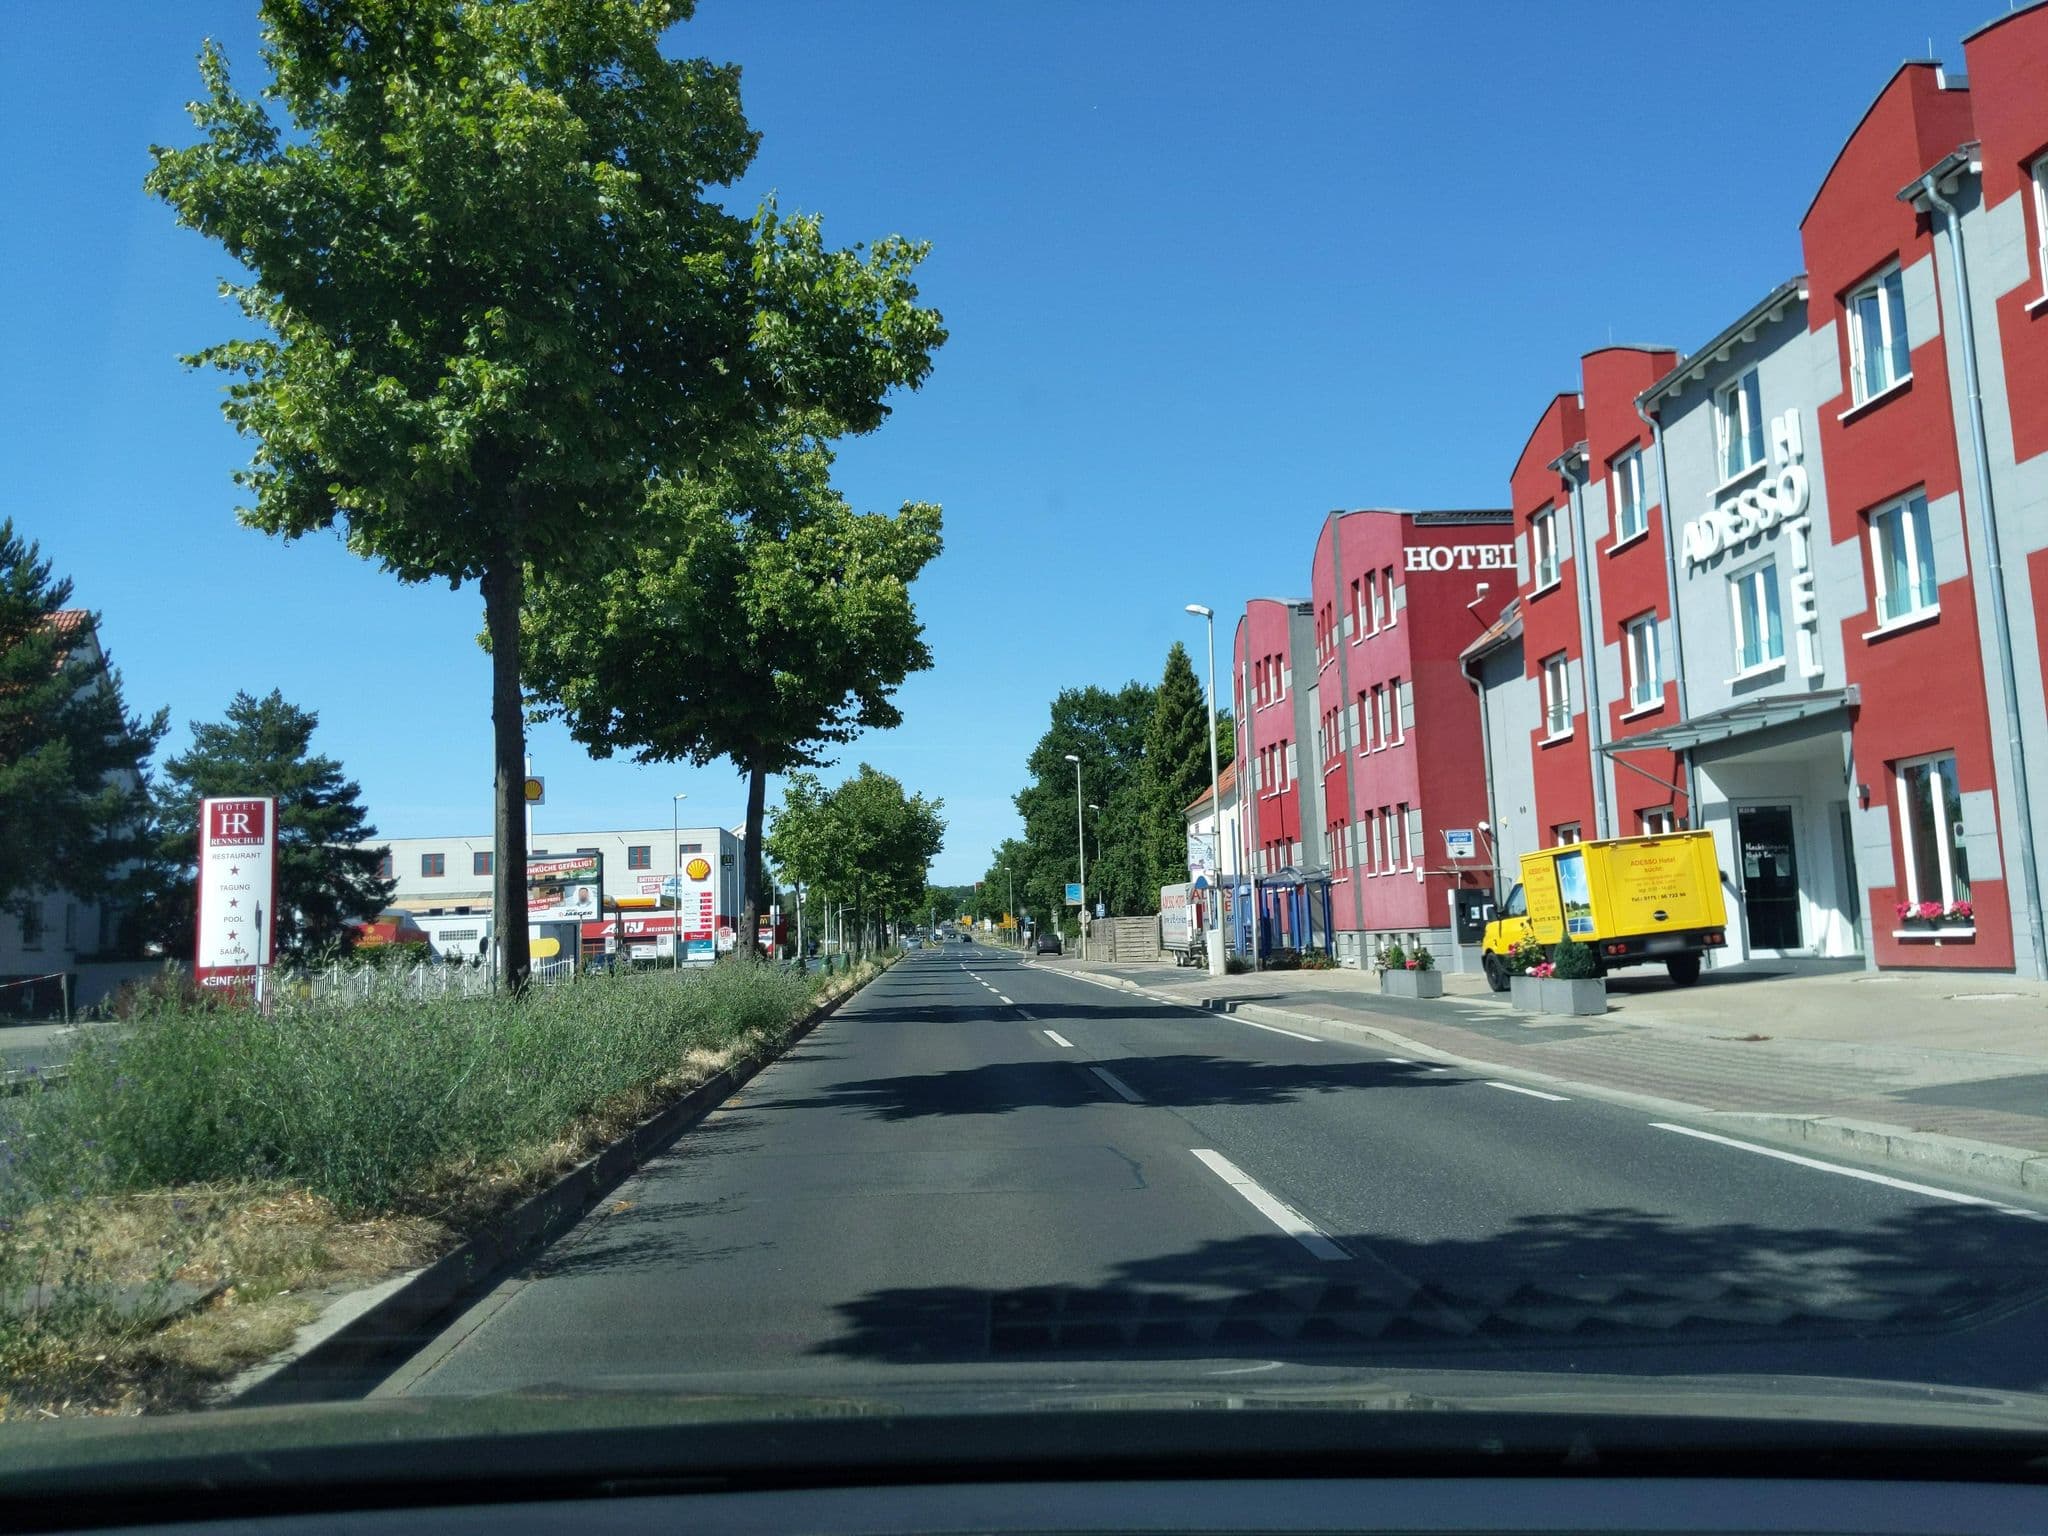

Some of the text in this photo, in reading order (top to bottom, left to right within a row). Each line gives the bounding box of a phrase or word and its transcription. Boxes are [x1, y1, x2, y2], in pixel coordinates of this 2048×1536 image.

[1681, 465, 1809, 569] ADESSO
[1771, 408, 1824, 678] HOTEL
[1403, 544, 1518, 571] HOTEL
[217, 803, 257, 811] HOTEL
[220, 813, 253, 835] HR
[211, 837, 264, 846] RENNSCHUH
[212, 852, 261, 860] RESTAURANT
[209, 975, 258, 985] EINFAHR
